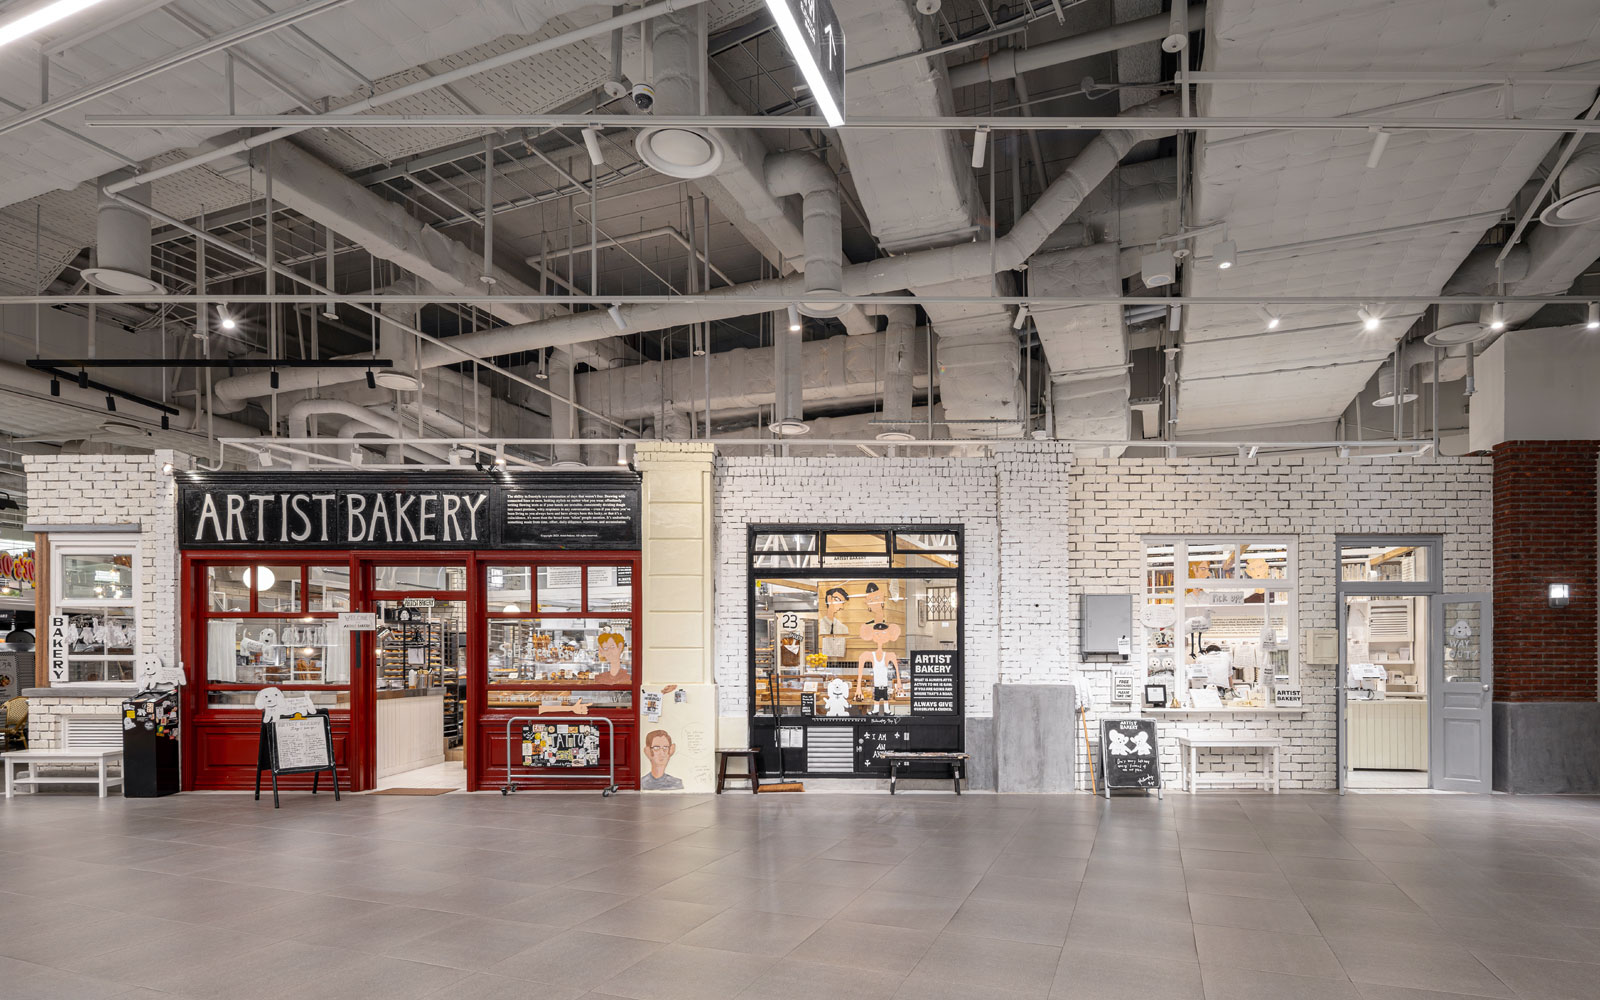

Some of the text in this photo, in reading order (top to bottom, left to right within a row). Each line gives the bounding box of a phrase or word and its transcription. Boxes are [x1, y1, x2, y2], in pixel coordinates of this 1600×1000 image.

[195, 493, 487, 542] ARTIST BAKERY
[782, 614, 798, 628] 23
[53, 618, 64, 679] BAKERY
[1450, 640, 1470, 648] WAY
[915, 655, 952, 664] ARTIST
[915, 665, 952, 673] BAKERY
